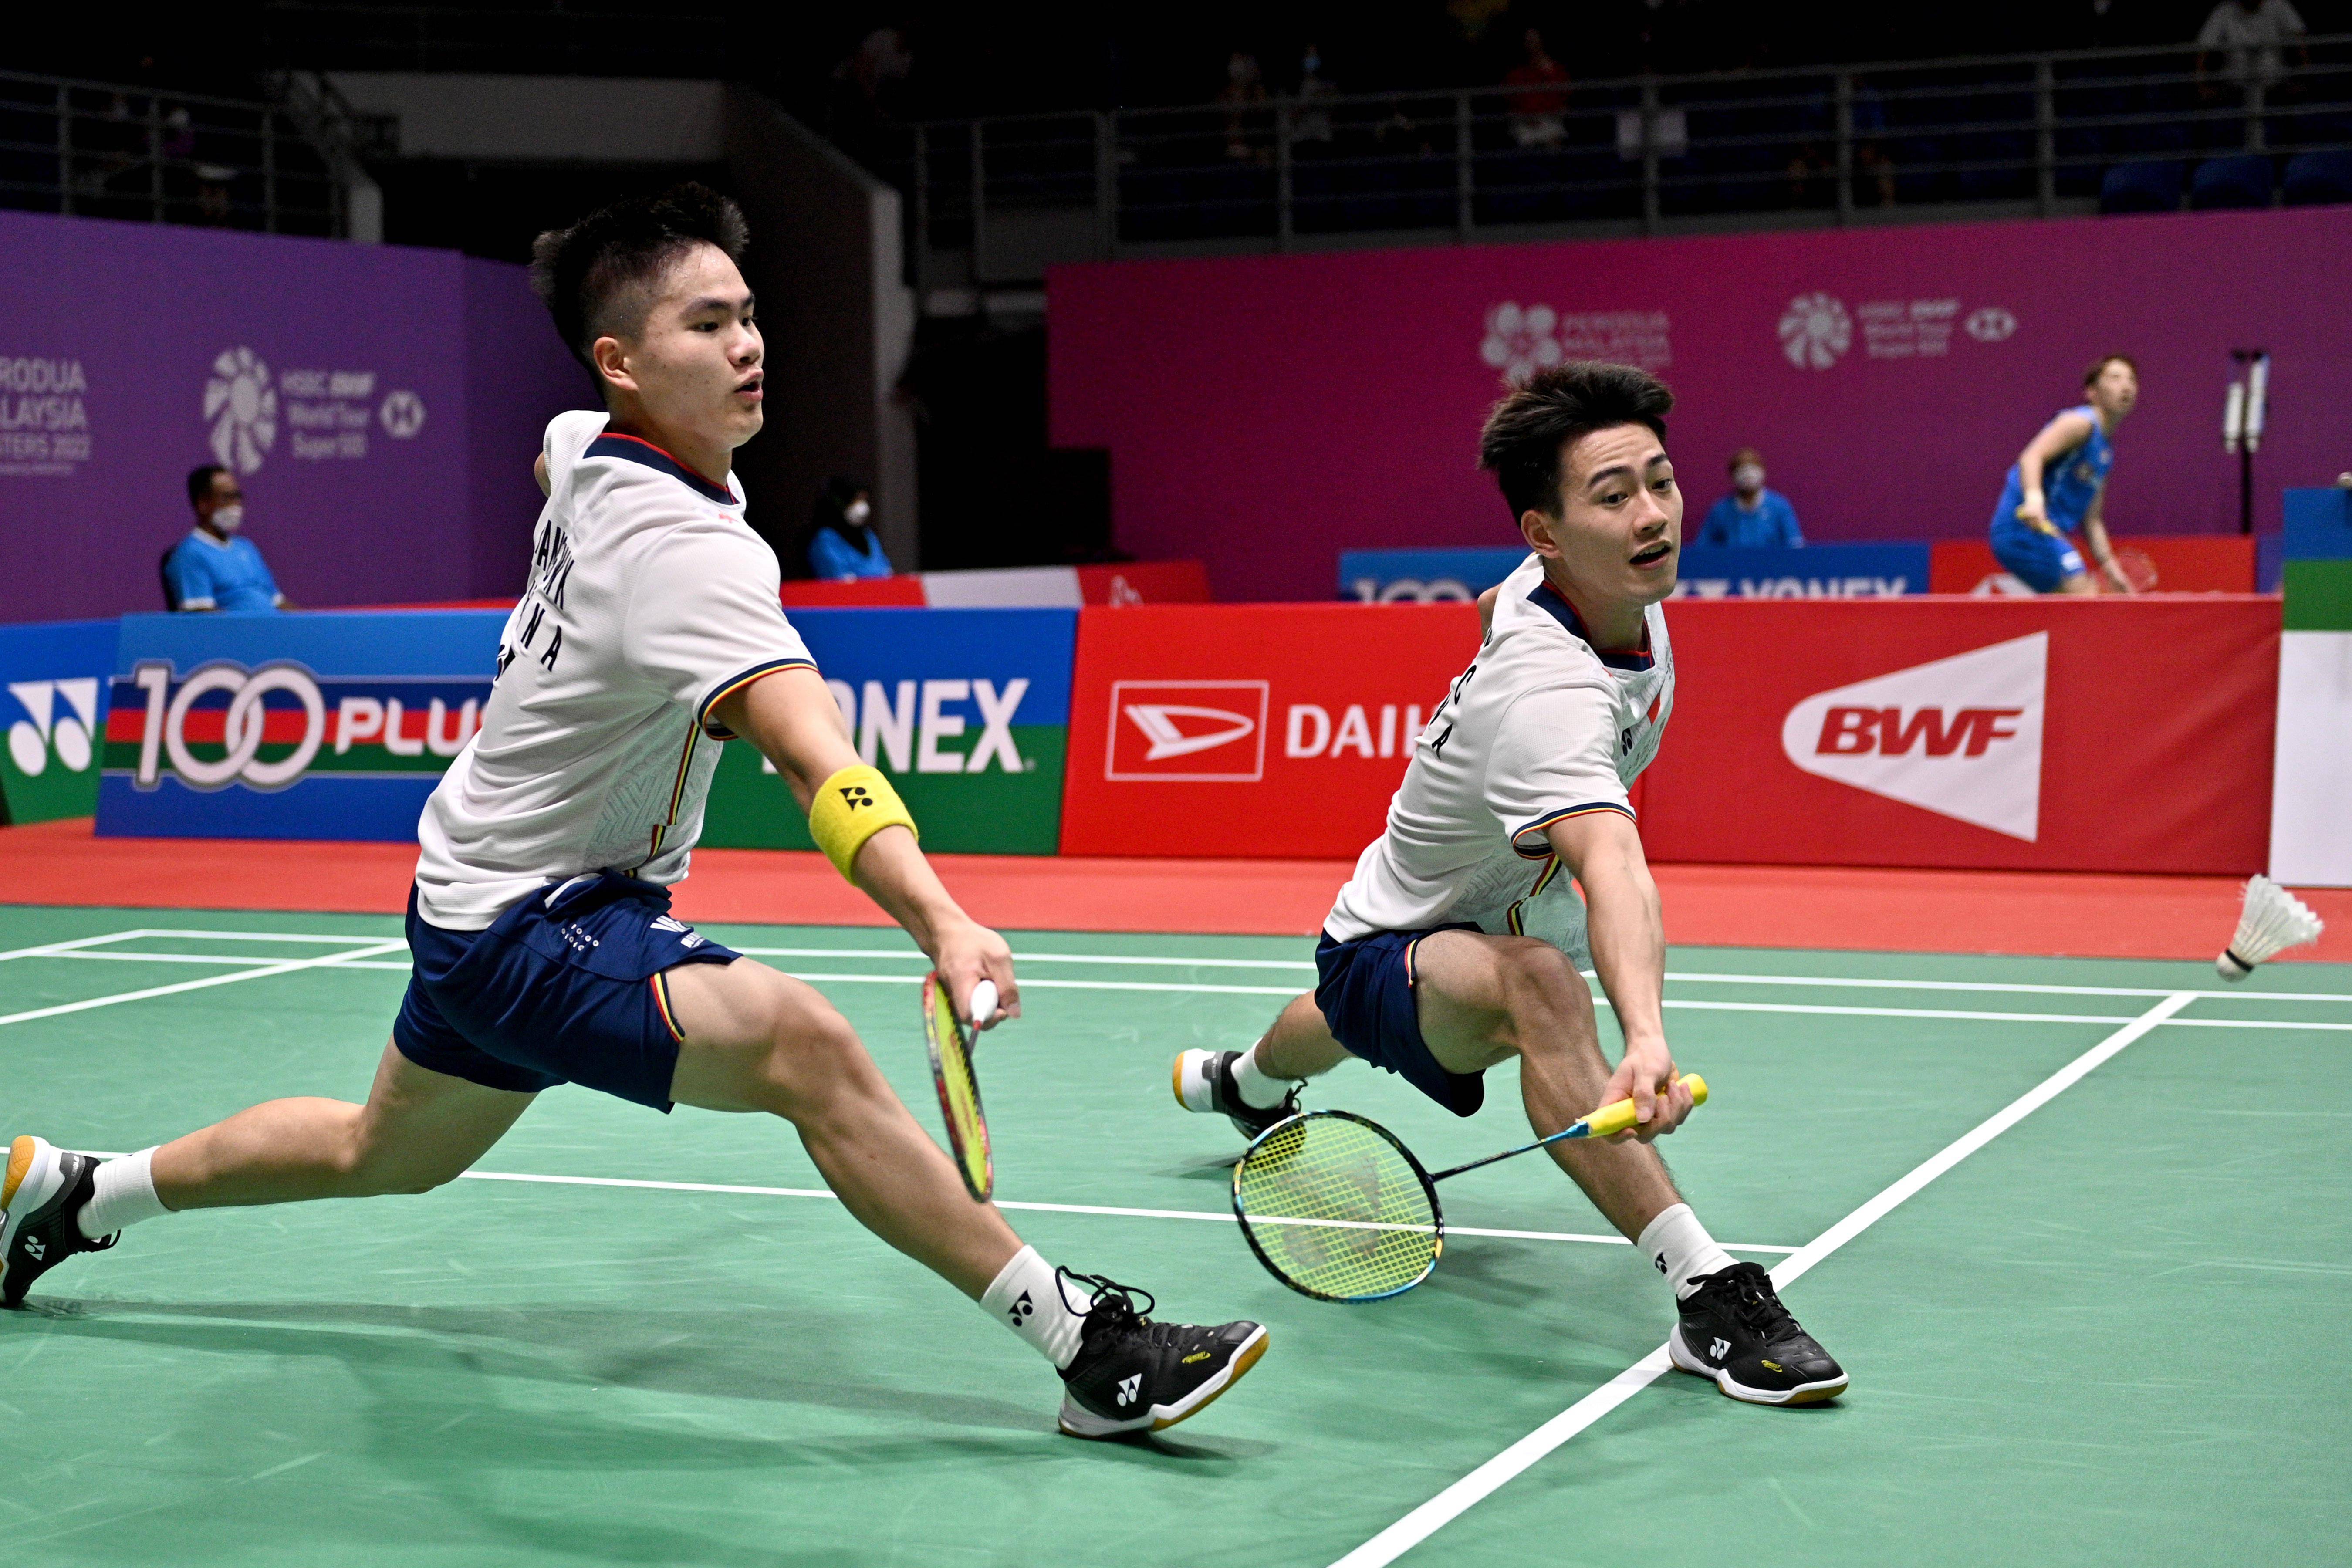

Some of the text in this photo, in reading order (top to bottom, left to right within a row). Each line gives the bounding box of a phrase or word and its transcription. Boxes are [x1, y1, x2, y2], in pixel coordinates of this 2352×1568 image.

[134, 666, 491, 784] 100 PLU
[1815, 706, 2024, 757] BWF
